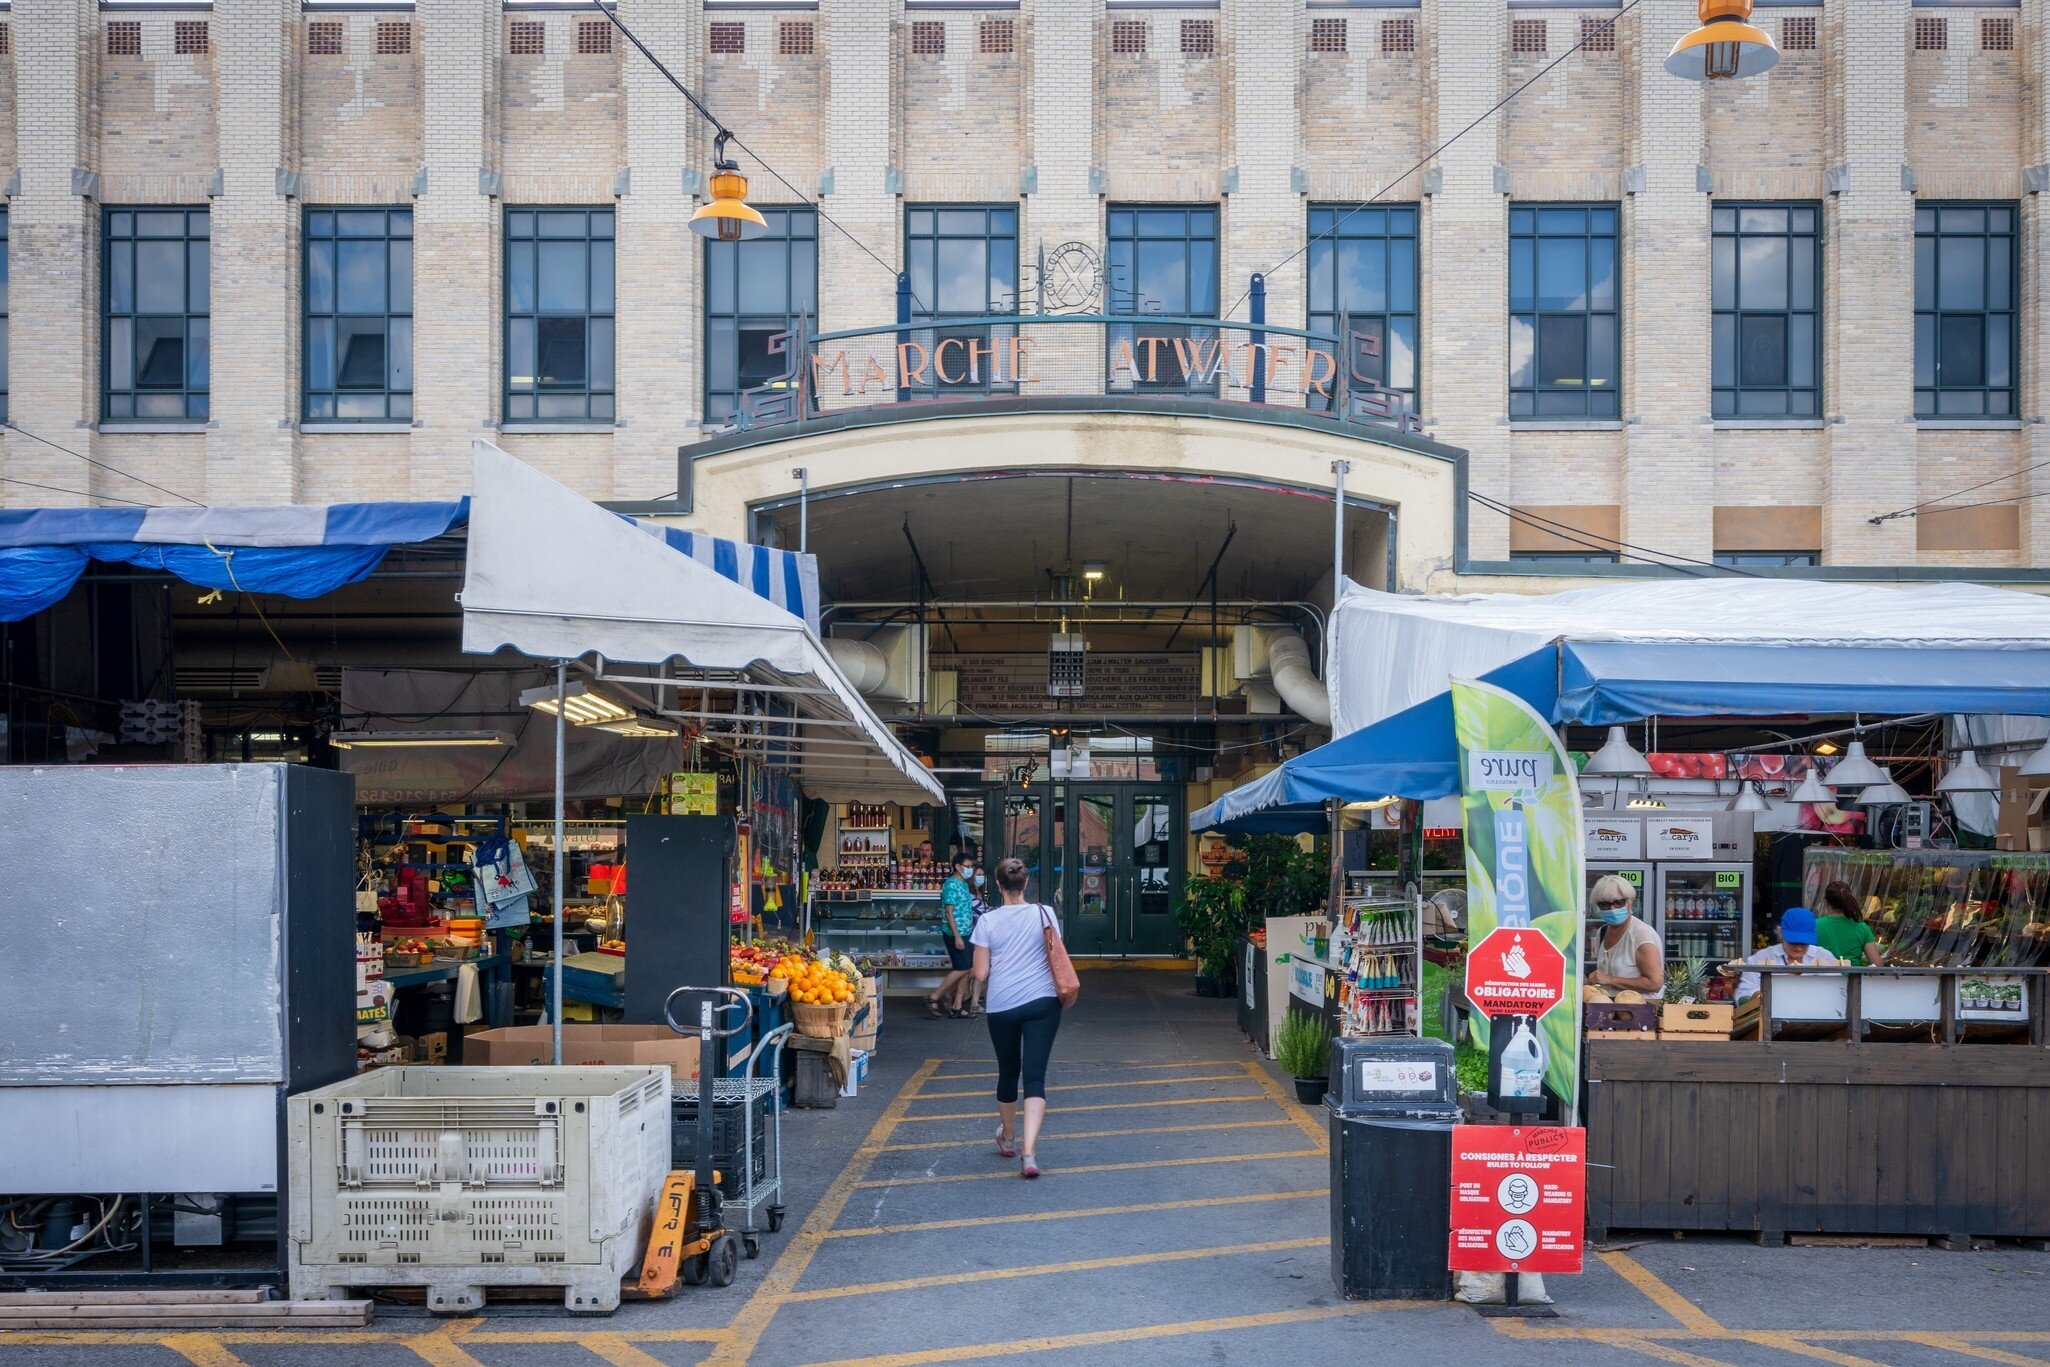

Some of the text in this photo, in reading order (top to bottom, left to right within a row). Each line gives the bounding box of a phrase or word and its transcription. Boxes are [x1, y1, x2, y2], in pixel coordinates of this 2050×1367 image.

[1044, 243, 1104, 298] CONCORDIA SALUS
[1107, 336, 1338, 399] ATWATER
[1599, 834, 1628, 843] carya
[1671, 833, 1700, 843] carya
[1620, 873, 1637, 882] BIO
[1718, 874, 1735, 882] BIO
[1474, 986, 1556, 999] OBLIGATOIRE
[1483, 1000, 1544, 1009] MANDATORY
[1528, 1132, 1564, 1148] PUBLICS
[1460, 1151, 1577, 1163] CONSIGNES À RESPECTER
